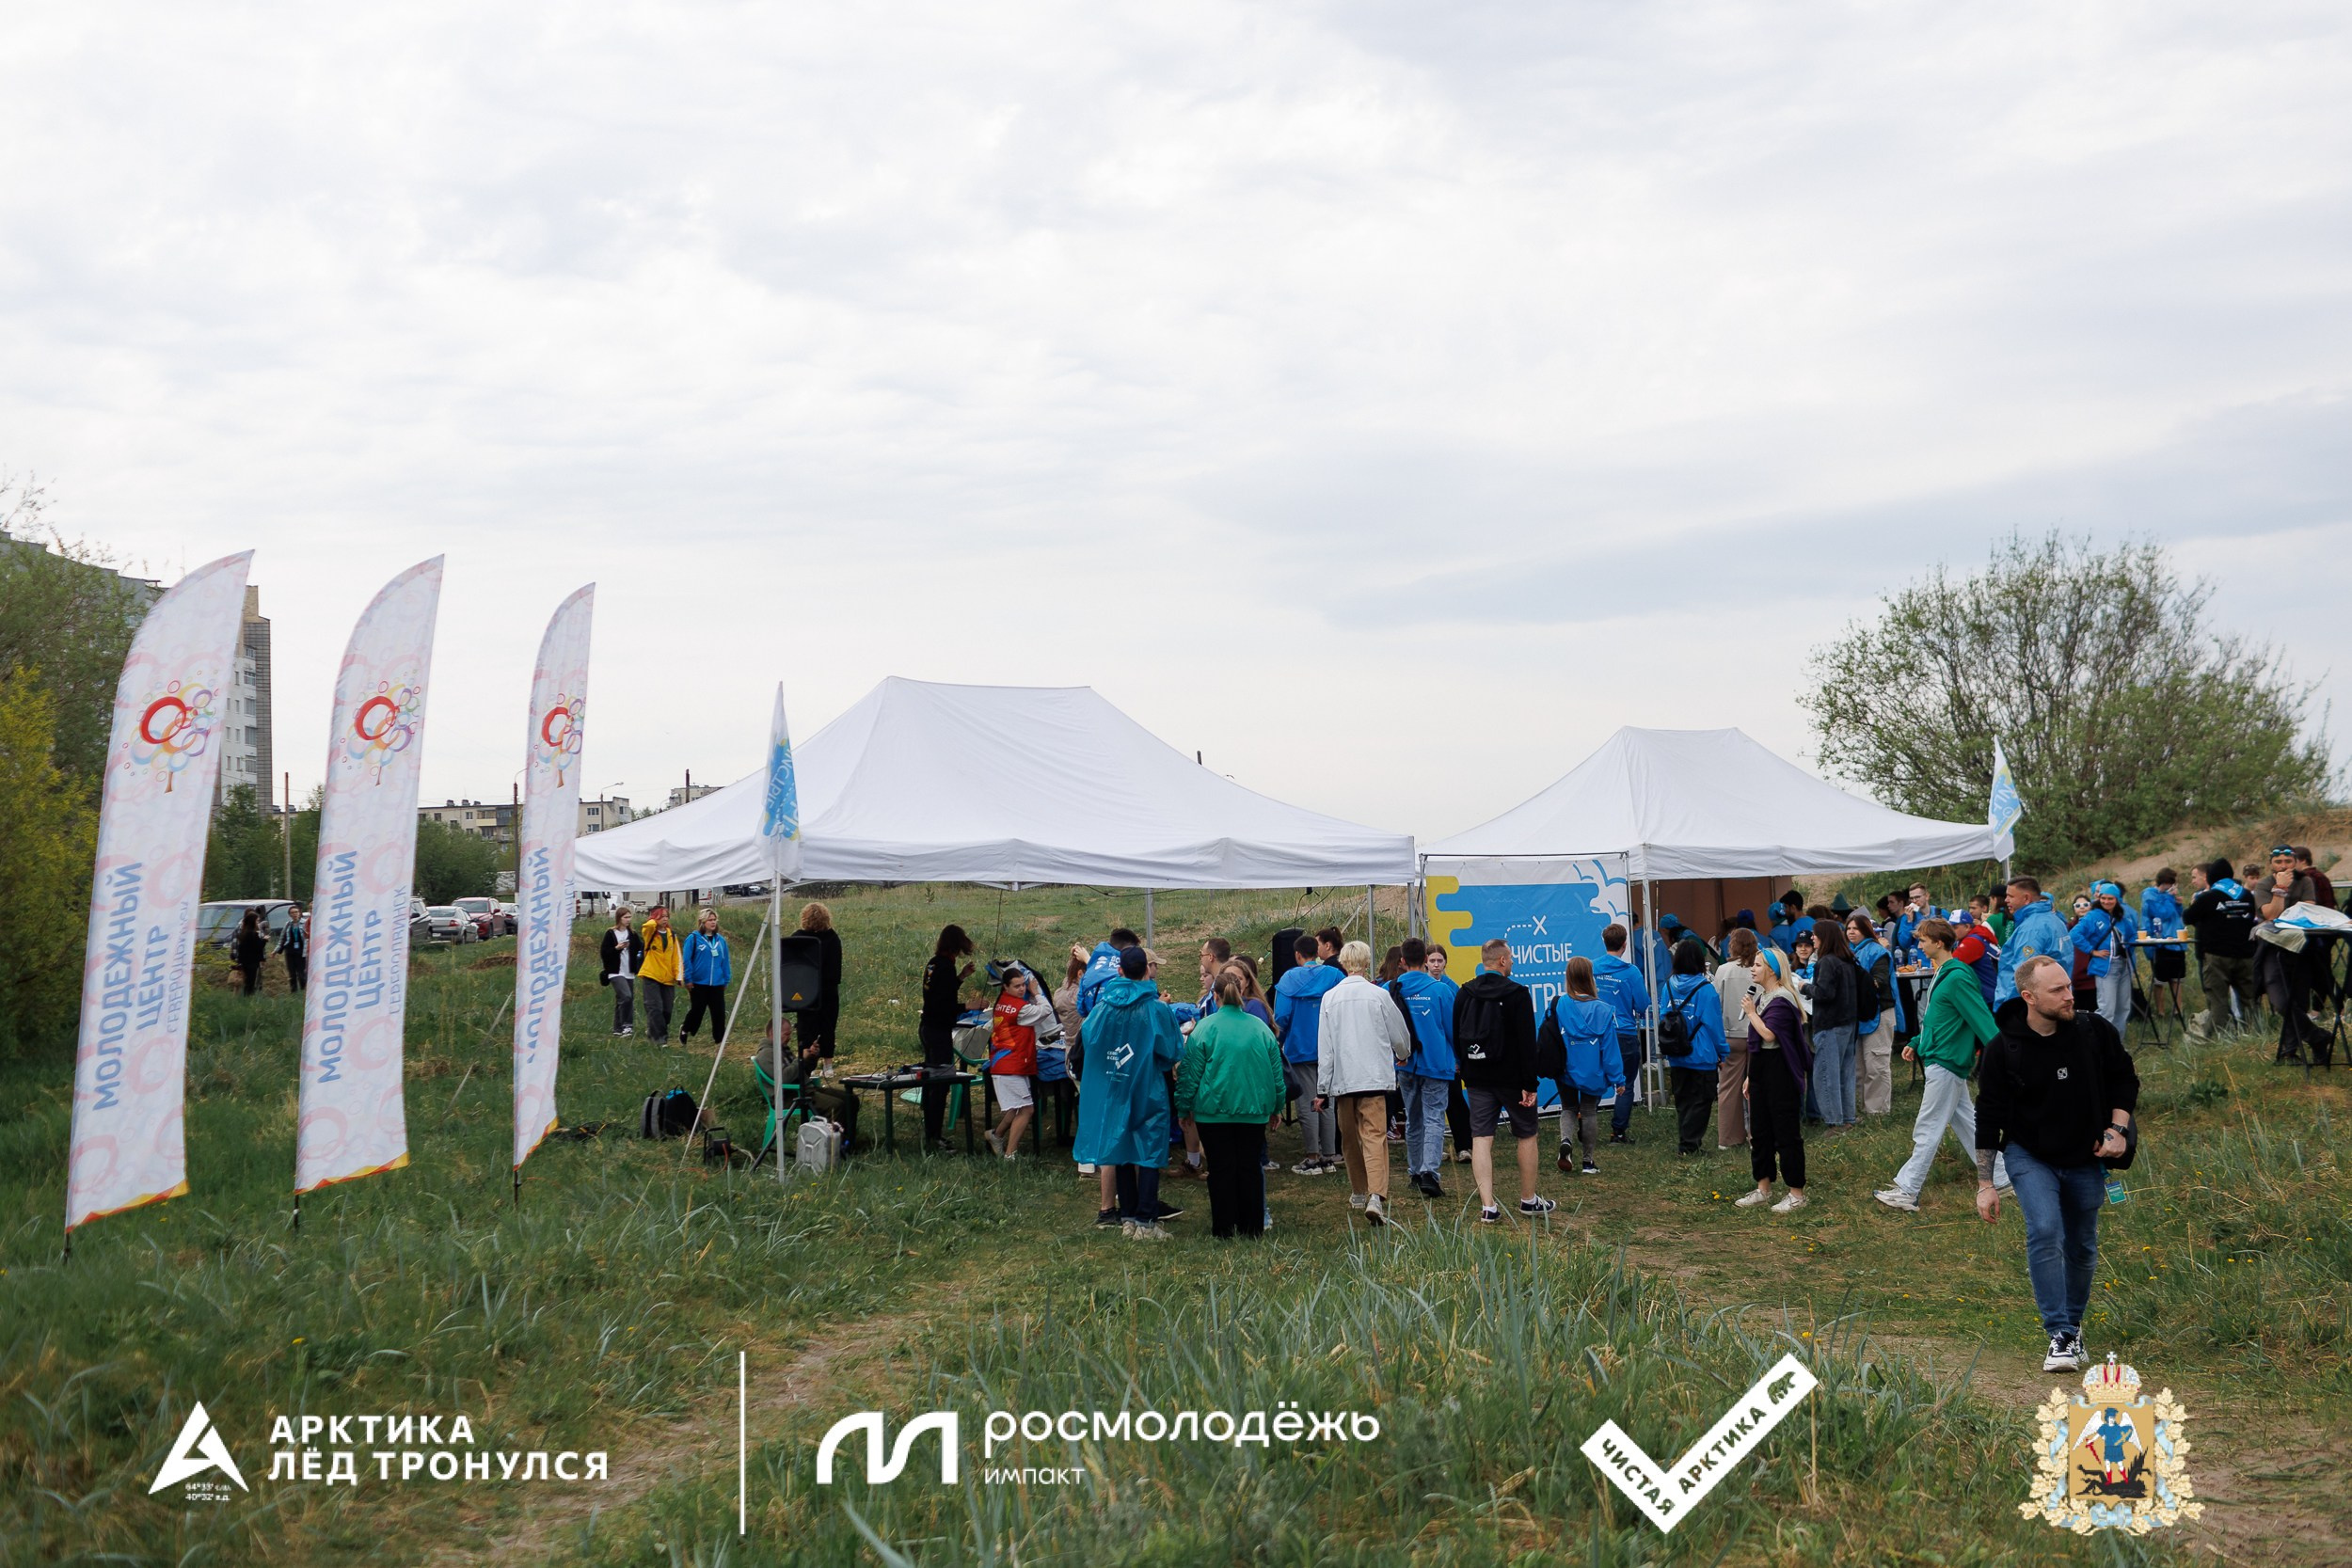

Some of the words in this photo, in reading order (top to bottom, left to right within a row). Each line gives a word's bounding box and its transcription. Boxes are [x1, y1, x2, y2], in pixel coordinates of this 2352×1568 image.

[92, 862, 142, 1111] МОЛОДЕЖНЫЙ
[135, 925, 169, 1031] ЦЕНТР
[318, 850, 358, 1083] МОЛОДЕЖНЫЙ
[354, 910, 386, 1010] ЦЕНТР
[1511, 942, 1573, 965] ЧИСТЫЕ
